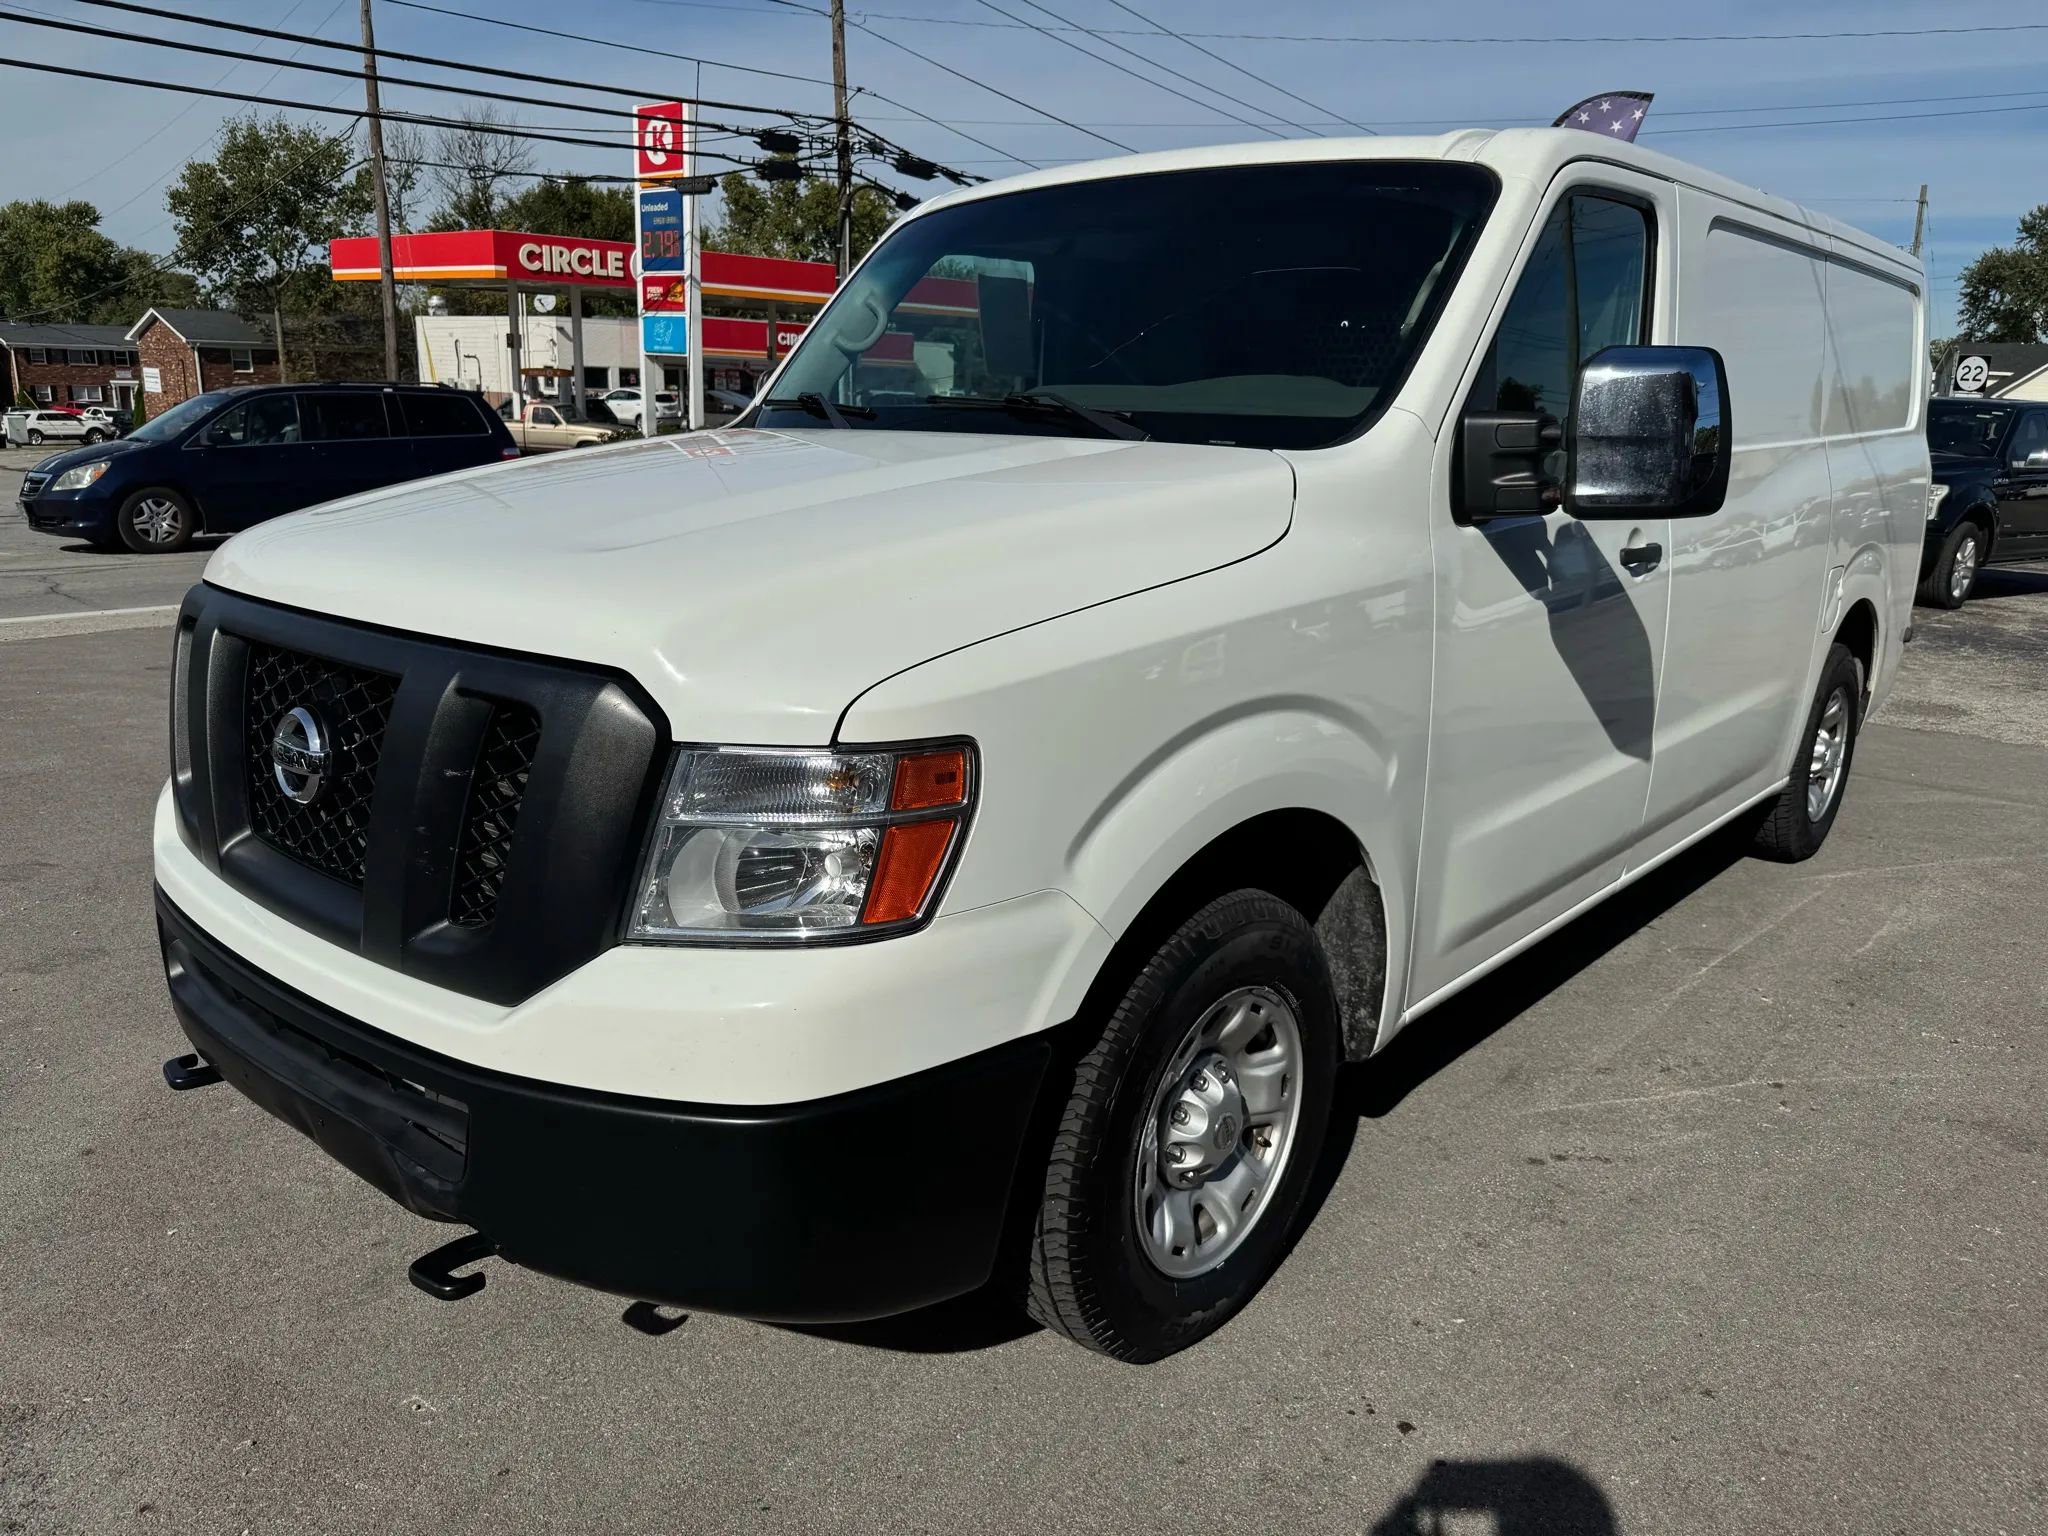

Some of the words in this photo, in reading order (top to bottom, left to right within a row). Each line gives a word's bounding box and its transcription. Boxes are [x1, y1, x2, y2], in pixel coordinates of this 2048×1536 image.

[641, 202, 669, 212] Unleaded
[518, 243, 625, 277] CIRCLE
[1960, 365, 1984, 382] 22
